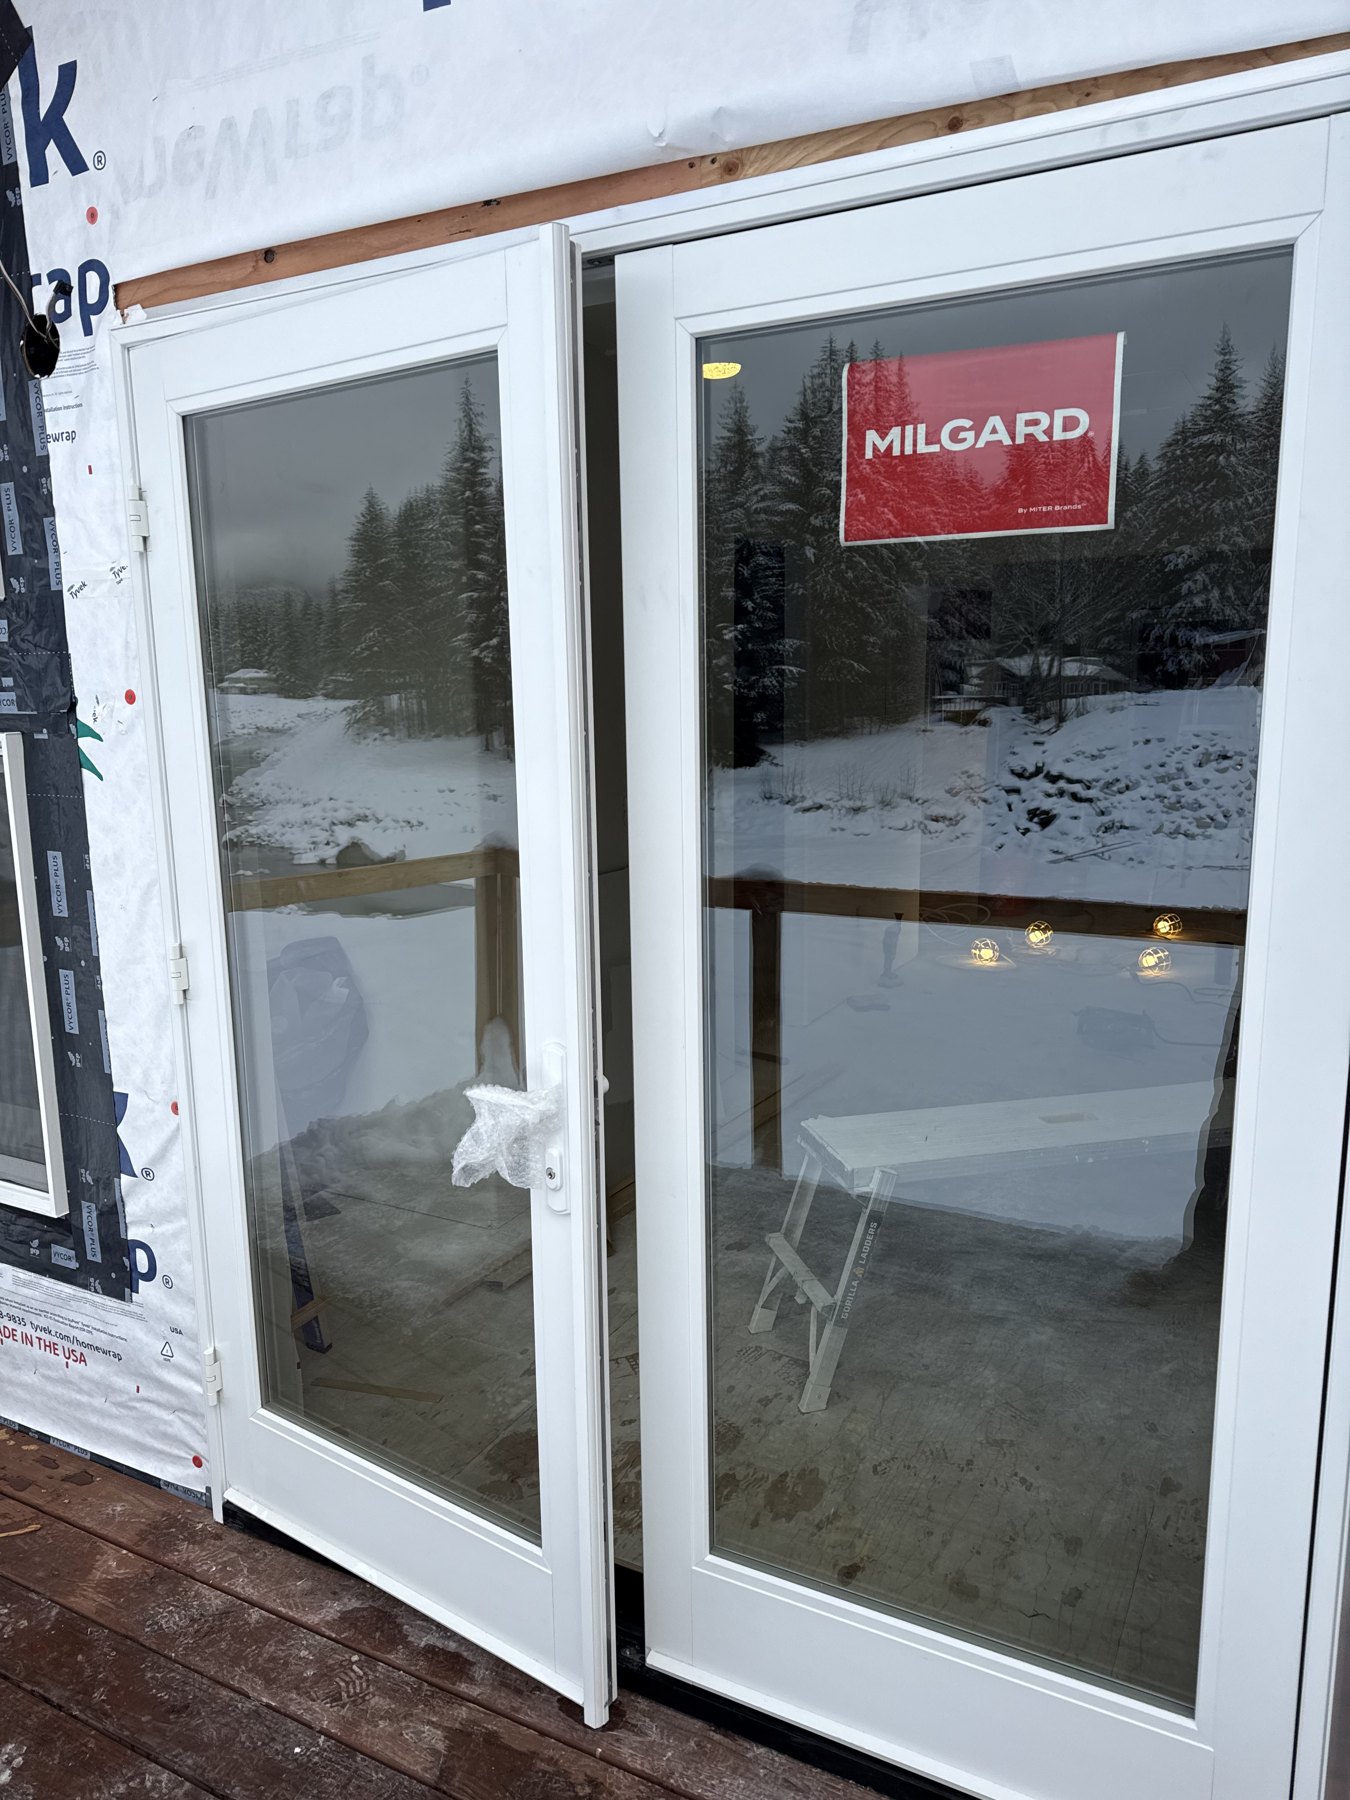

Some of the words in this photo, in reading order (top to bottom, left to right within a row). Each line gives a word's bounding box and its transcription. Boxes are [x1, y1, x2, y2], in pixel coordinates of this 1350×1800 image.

[865, 407, 1090, 460] MILGARD
[52, 855, 60, 878] PLUS
[55, 883, 63, 914] VYCOR
[65, 1001, 74, 1031] VYCOR
[841, 1280, 860, 1320] GORILLA
[858, 1222, 878, 1264] LADDERS
[30, 1320, 123, 1362] tyvek.com/homewrap
[169, 1326, 184, 1336] USA
[21, 1331, 33, 1348] IN
[35, 1336, 60, 1356] THE
[62, 1346, 88, 1366] USA
